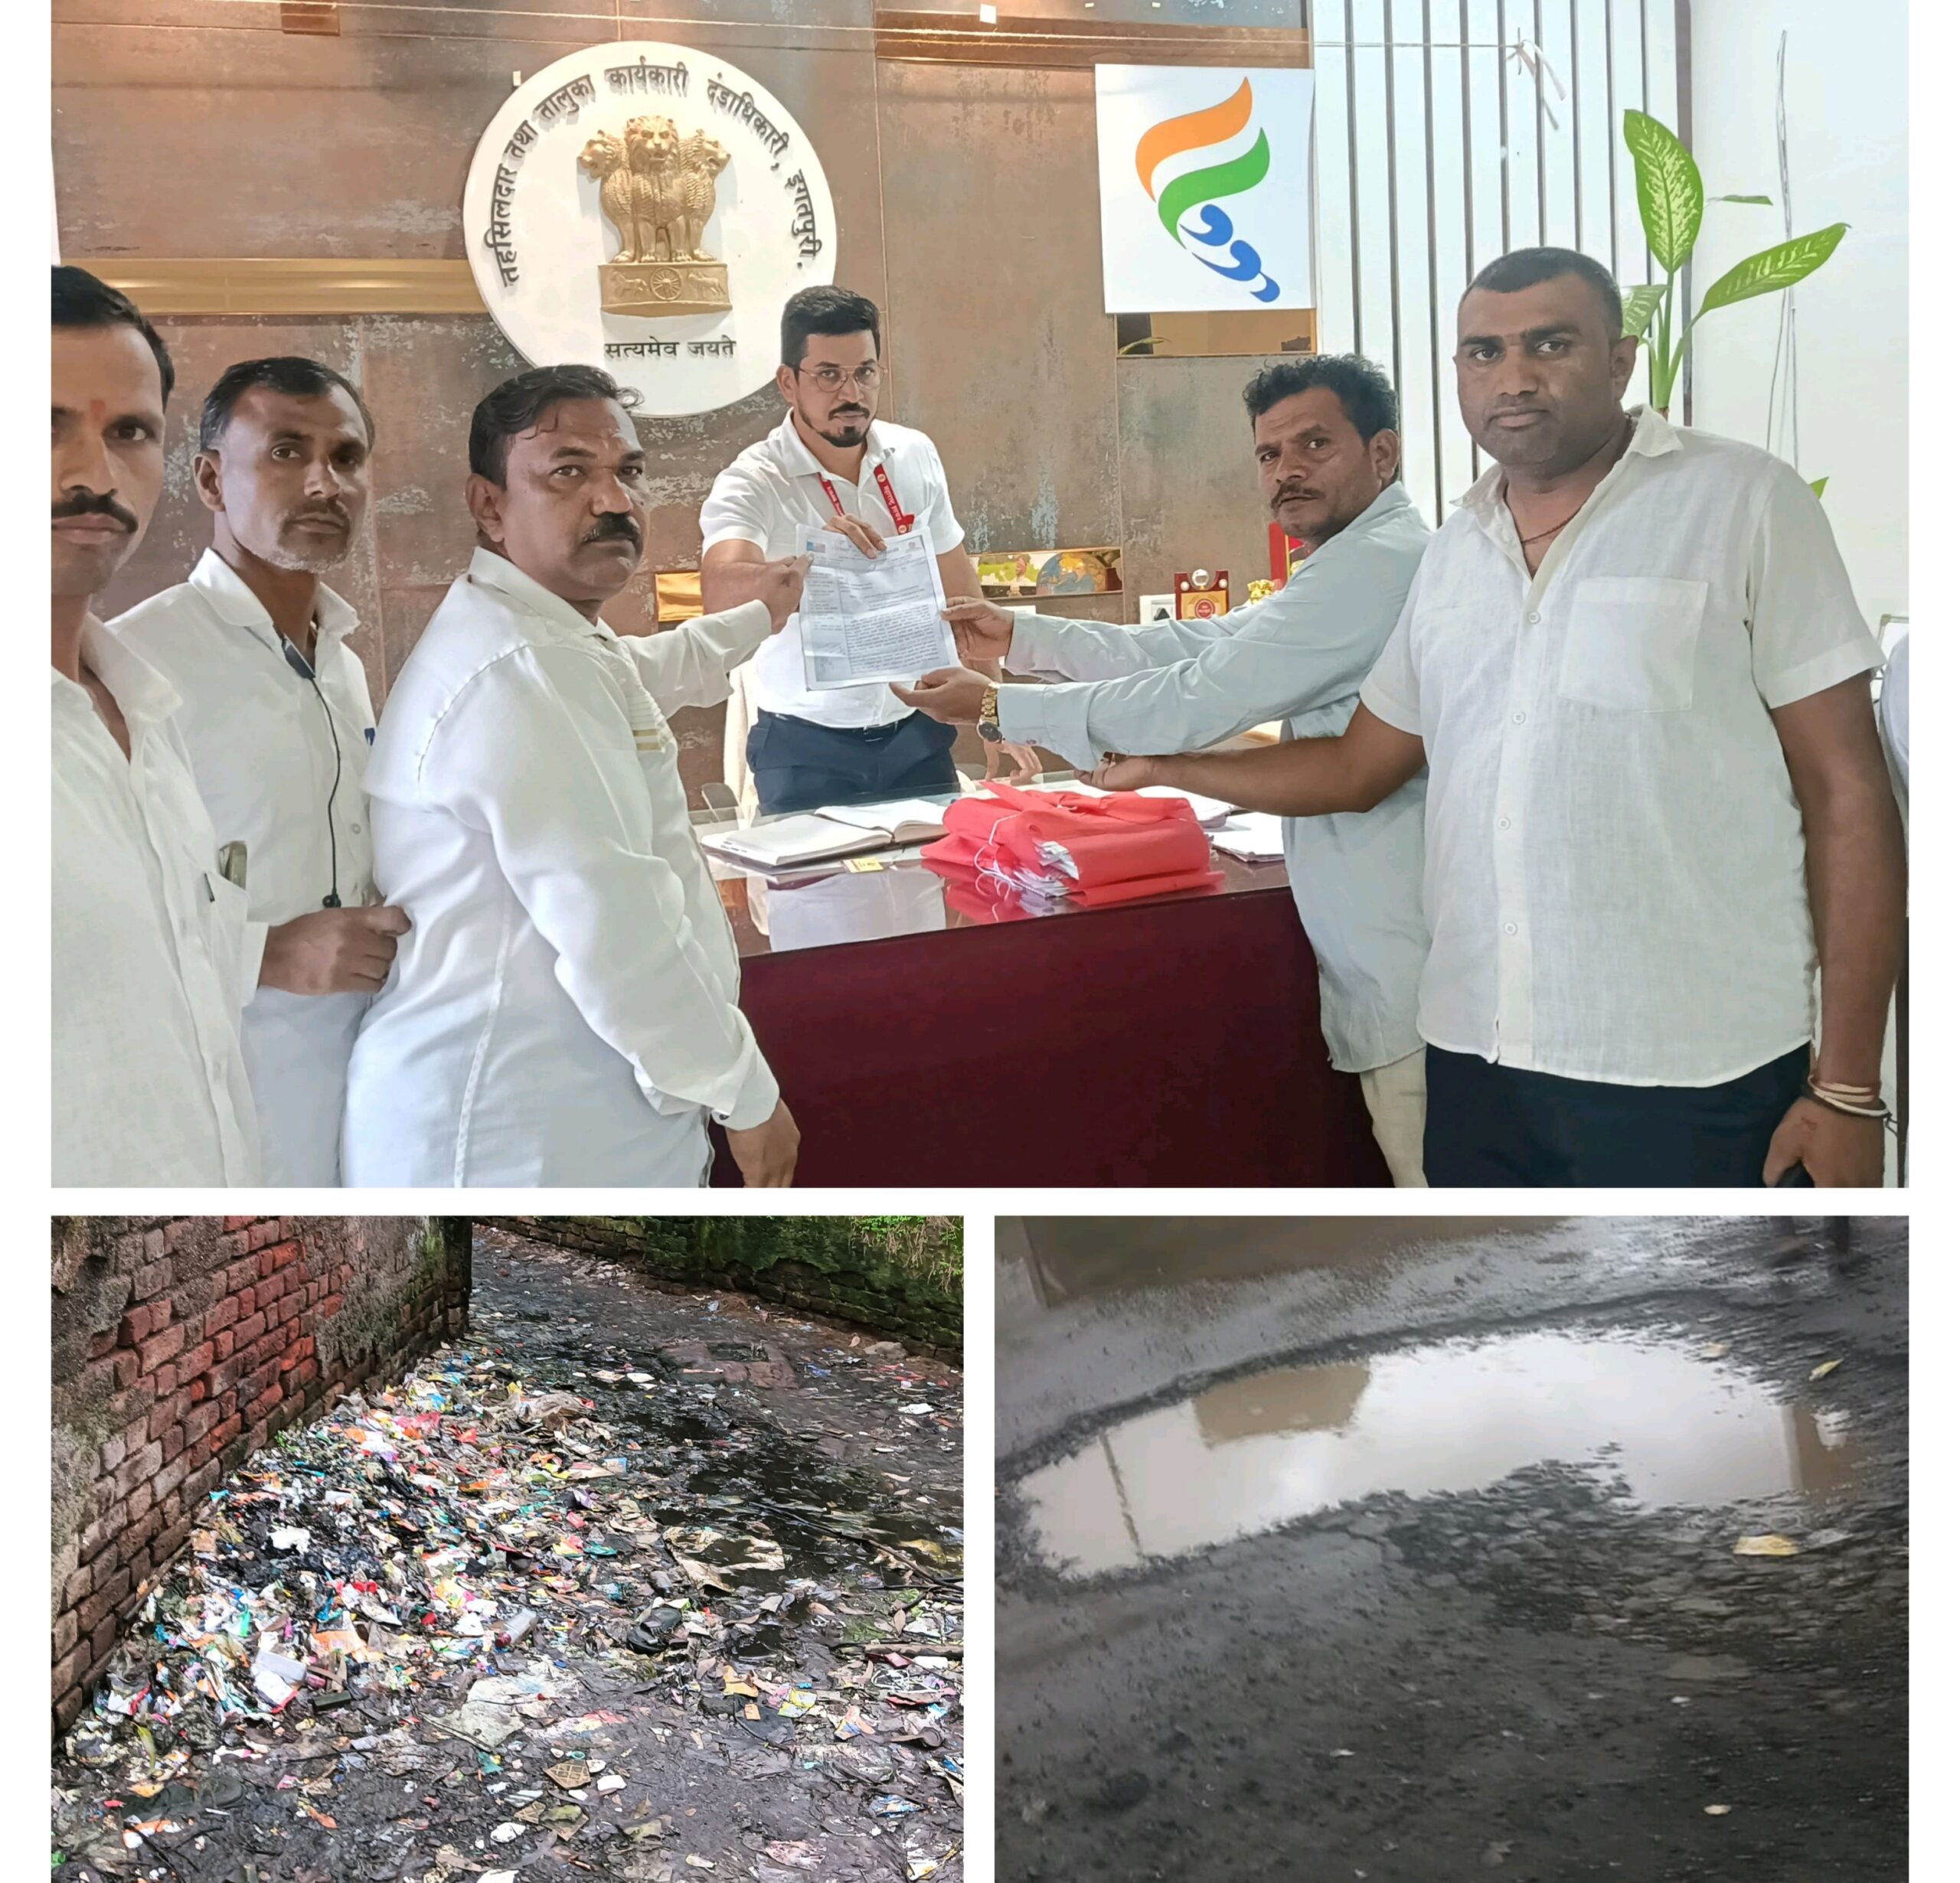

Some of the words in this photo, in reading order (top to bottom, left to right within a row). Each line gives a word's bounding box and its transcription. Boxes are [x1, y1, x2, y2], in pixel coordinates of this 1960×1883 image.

[483, 162, 520, 288] तहसिलदार
[503, 119, 539, 159] तथा
[532, 73, 596, 120] तालुका
[603, 54, 689, 91] कार्यकारी
[707, 71, 790, 172] दंडाधिकारी,
[783, 168, 823, 269] इगतपुरी.
[604, 335, 680, 358] सत्यमेव
[687, 334, 737, 357] जयते
